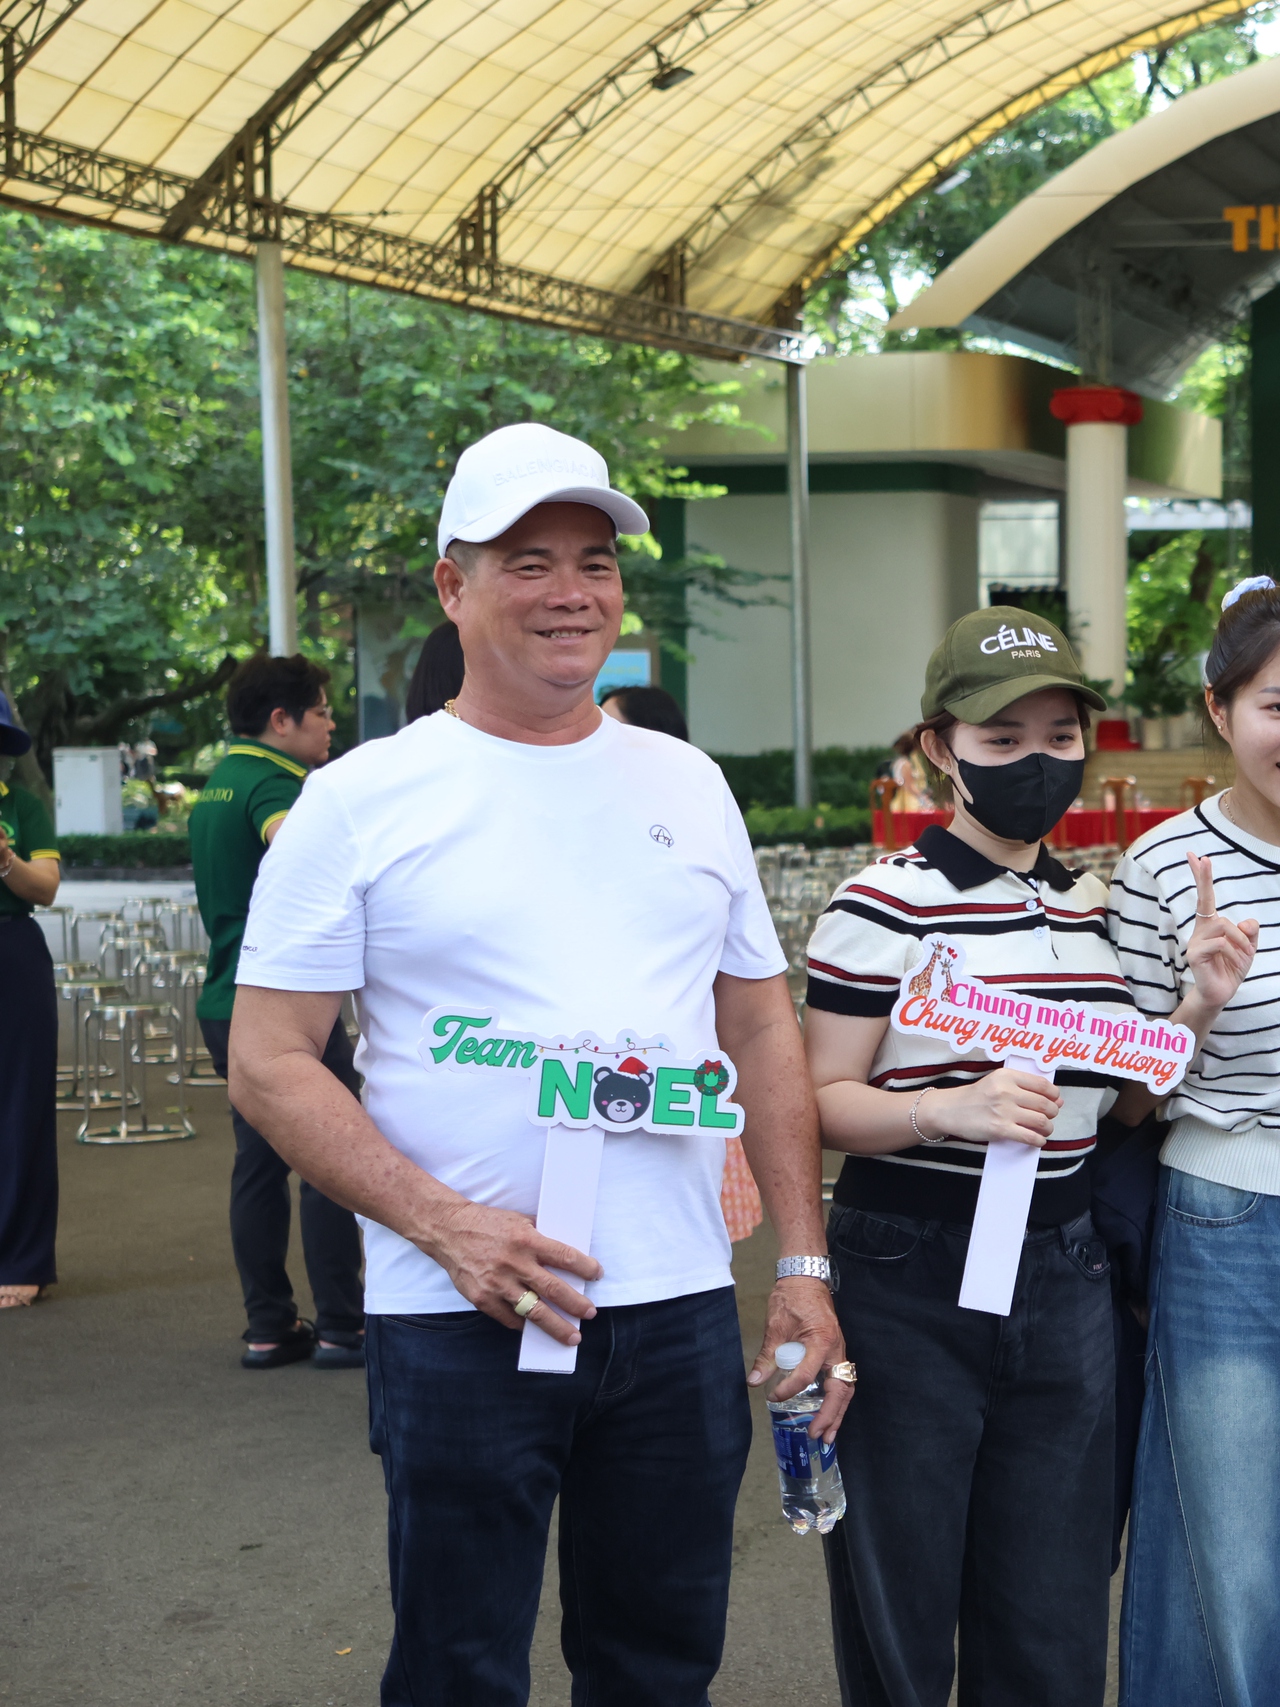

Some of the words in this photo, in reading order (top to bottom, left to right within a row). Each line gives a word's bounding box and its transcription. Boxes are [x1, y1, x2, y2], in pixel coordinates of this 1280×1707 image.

[980, 624, 1058, 655] CÉLINE
[1010, 649, 1041, 660] PARIS
[429, 1014, 539, 1069] Team
[899, 994, 982, 1046] Chung
[1042, 1034, 1091, 1064] yêu
[1093, 1036, 1179, 1087] thương
[949, 982, 1033, 1027] Chung
[1036, 1006, 1086, 1034] một
[1090, 1014, 1138, 1044] mái
[1140, 1026, 1188, 1054] nhà
[537, 1057, 738, 1130] NOEL
